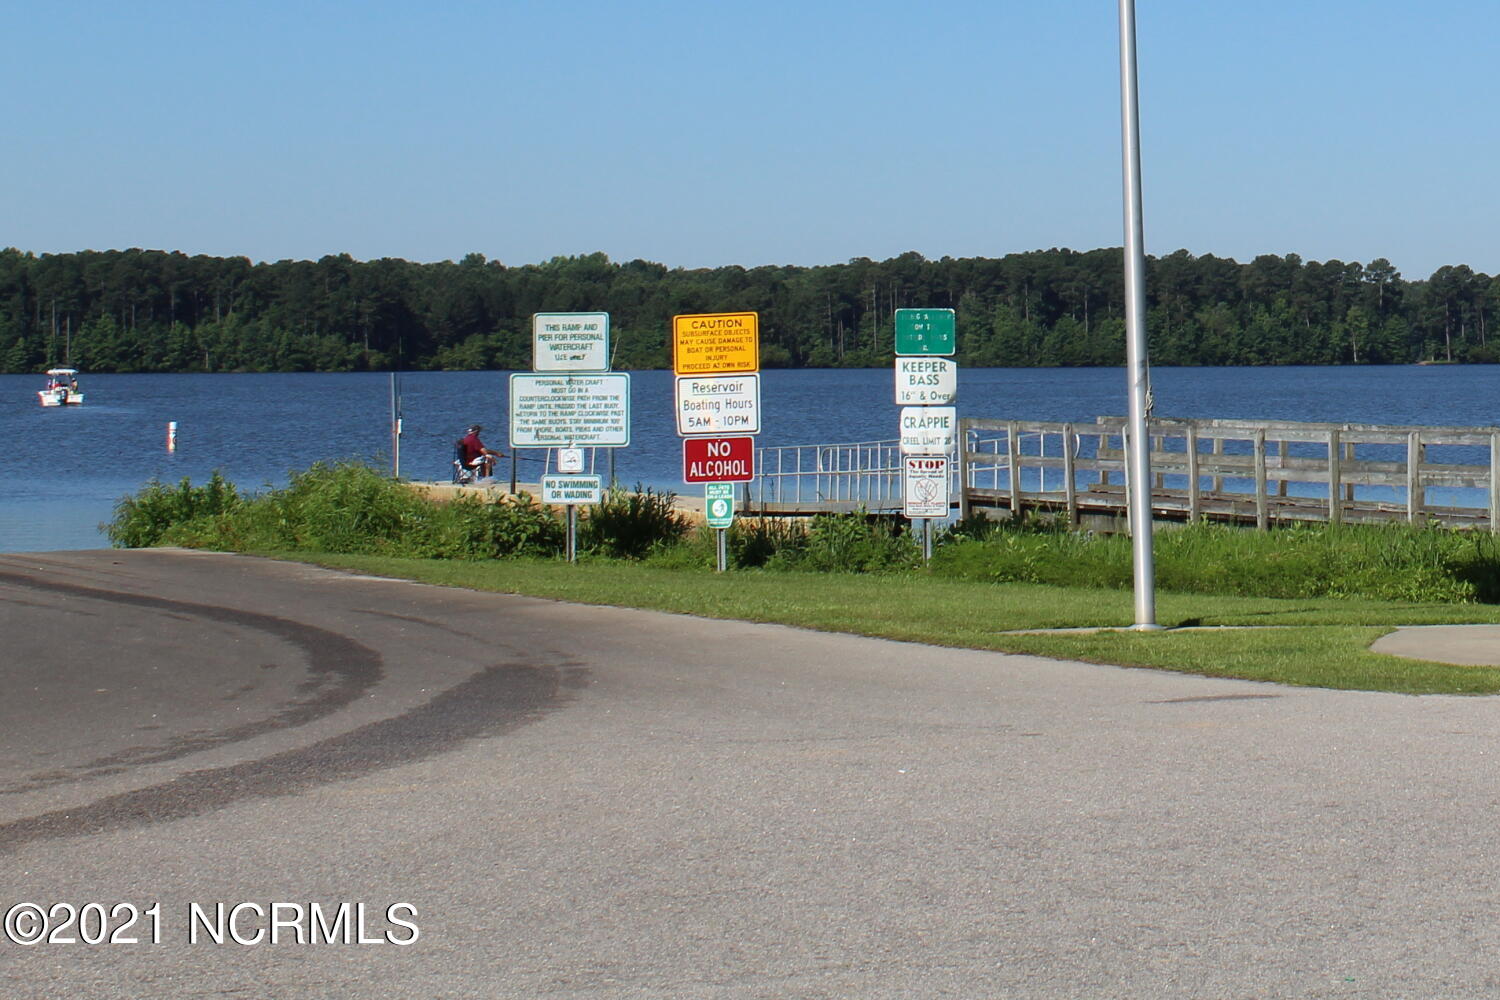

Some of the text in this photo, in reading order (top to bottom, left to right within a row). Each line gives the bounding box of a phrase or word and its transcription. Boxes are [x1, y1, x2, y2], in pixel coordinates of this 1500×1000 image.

[584, 323, 598, 331] AND
[691, 319, 743, 329] CAUTION
[538, 334, 553, 342] PIER
[569, 333, 604, 341] PERSONAL
[549, 343, 593, 351] WATERCRAFT
[902, 361, 948, 373] KEEPER
[909, 374, 940, 386] BASS
[692, 382, 743, 393] Reservoir
[920, 391, 926, 400] &
[684, 399, 753, 413] Boating Hours
[688, 417, 711, 427] 5AM
[723, 416, 749, 426] 10PM
[903, 416, 949, 428] CRAPPIE
[903, 436, 920, 445] CREEL
[923, 437, 941, 445] LIMIT
[707, 442, 731, 457] NO
[690, 460, 749, 477] ALCOHOL
[908, 460, 944, 469] STOP
[546, 480, 598, 489] NO SWIMMING
[551, 490, 592, 499] OR WADING
